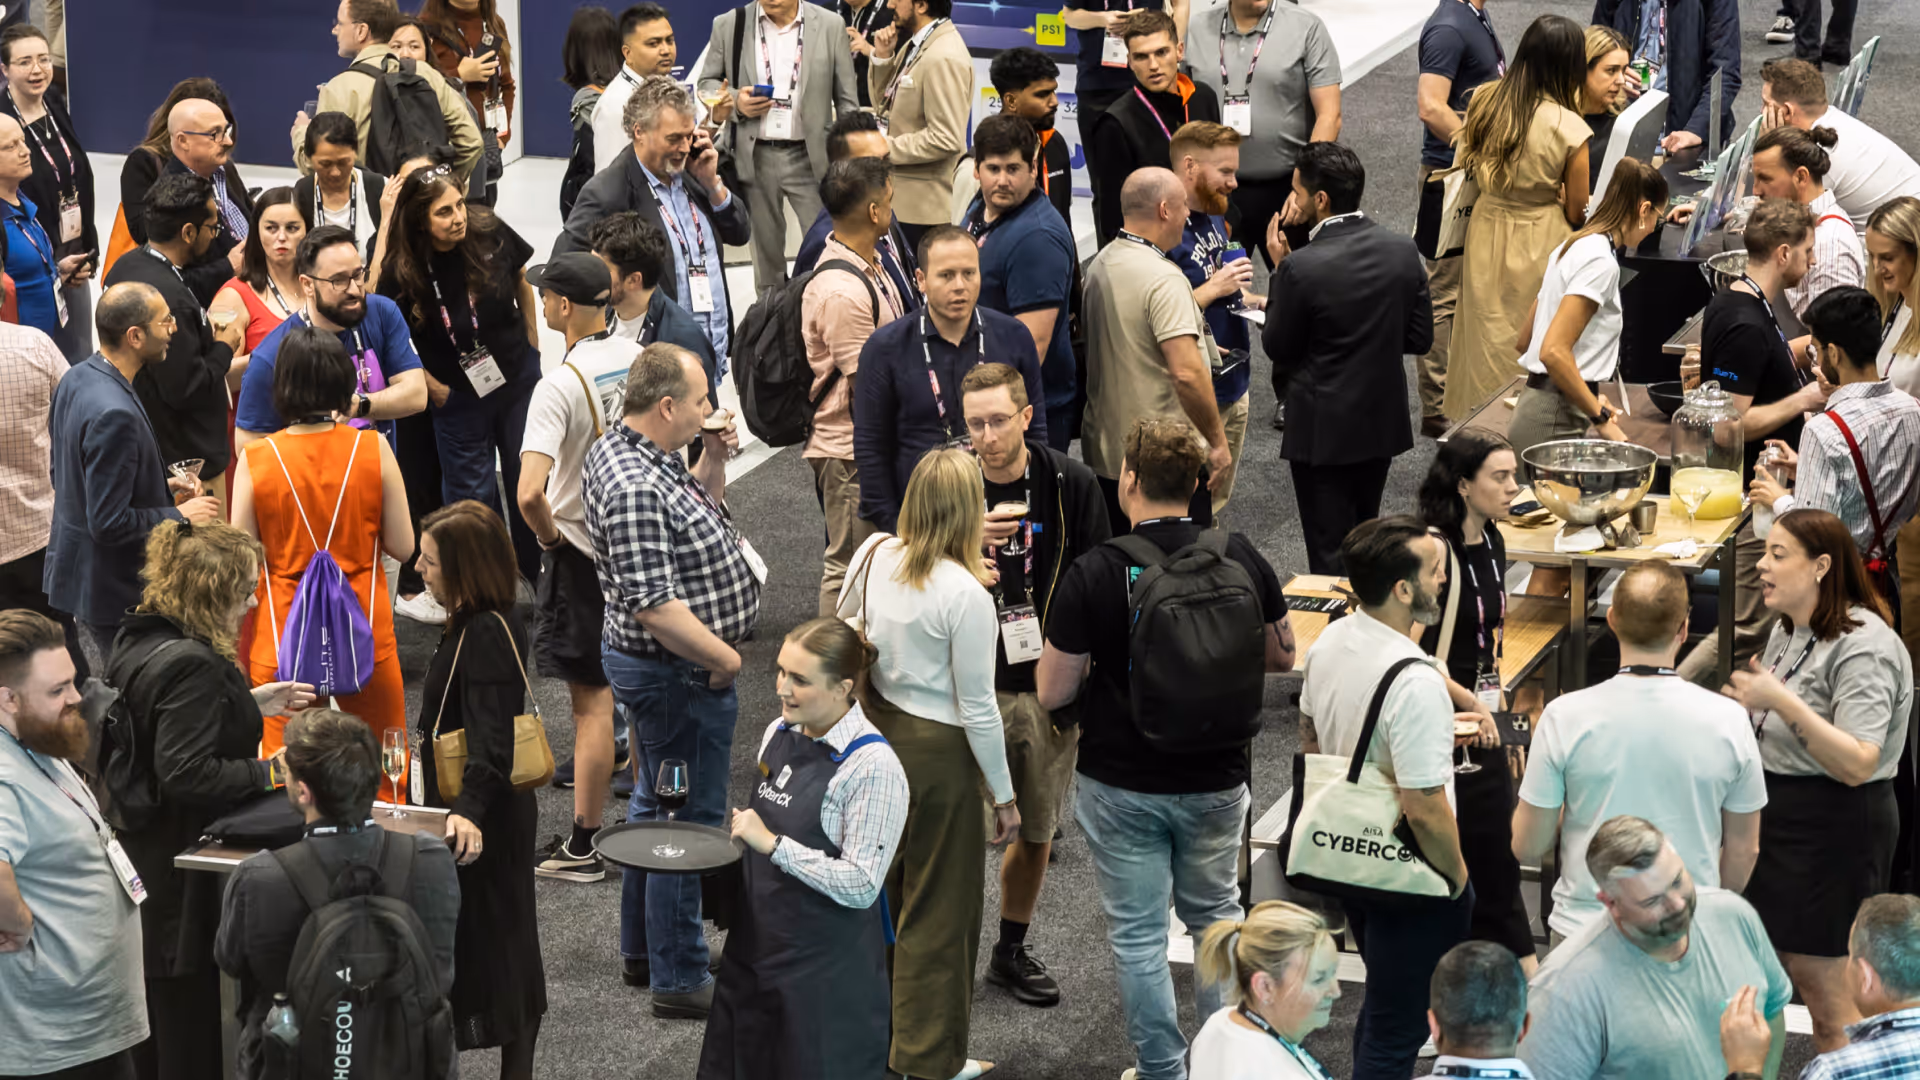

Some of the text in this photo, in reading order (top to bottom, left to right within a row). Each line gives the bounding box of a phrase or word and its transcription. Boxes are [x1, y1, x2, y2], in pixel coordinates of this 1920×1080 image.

[1041, 24, 1061, 35] PS1
[757, 781, 793, 808] CyberCX
[1311, 830, 1417, 864] CYBERCO
